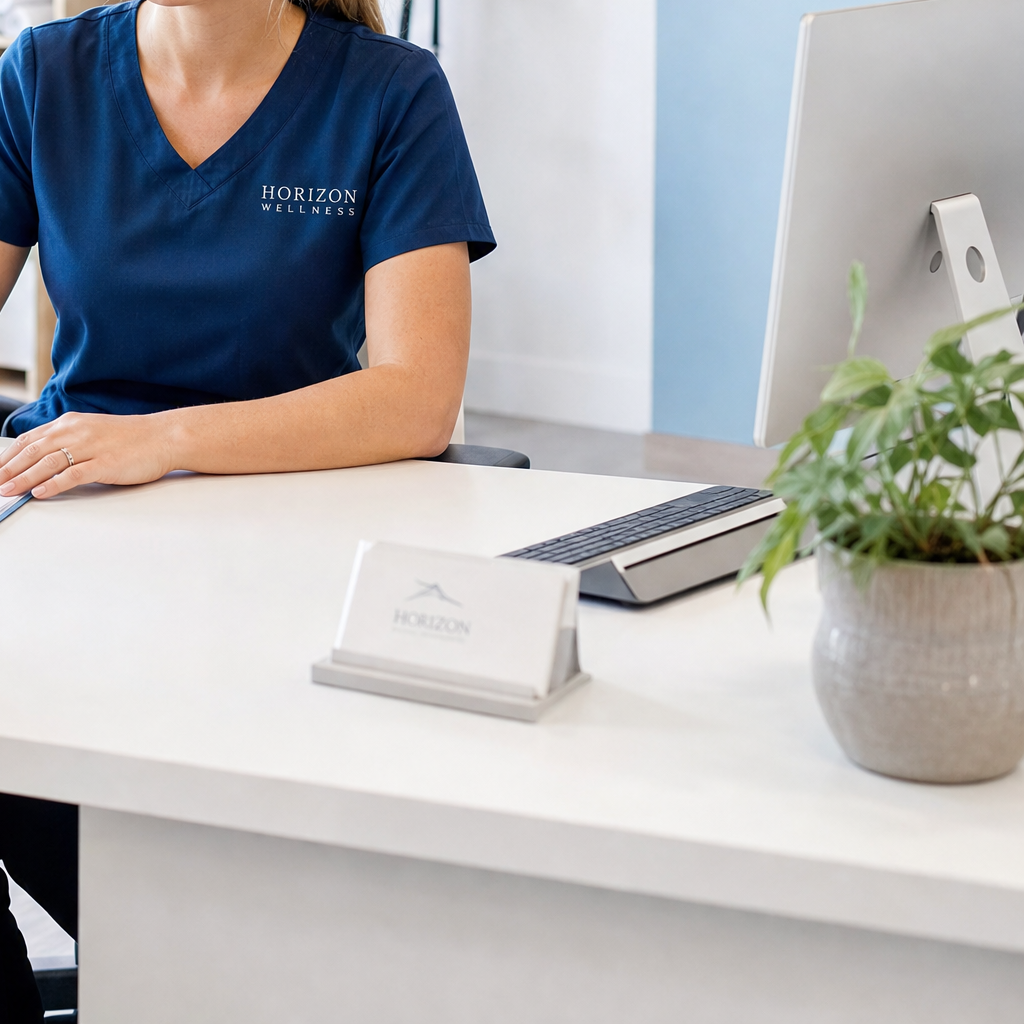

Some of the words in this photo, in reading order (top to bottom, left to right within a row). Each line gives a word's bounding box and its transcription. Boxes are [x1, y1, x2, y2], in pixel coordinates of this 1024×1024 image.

[261, 185, 357, 203] HORIZON
[261, 203, 355, 216] WELLNESS
[393, 609, 471, 636] HORIZON
